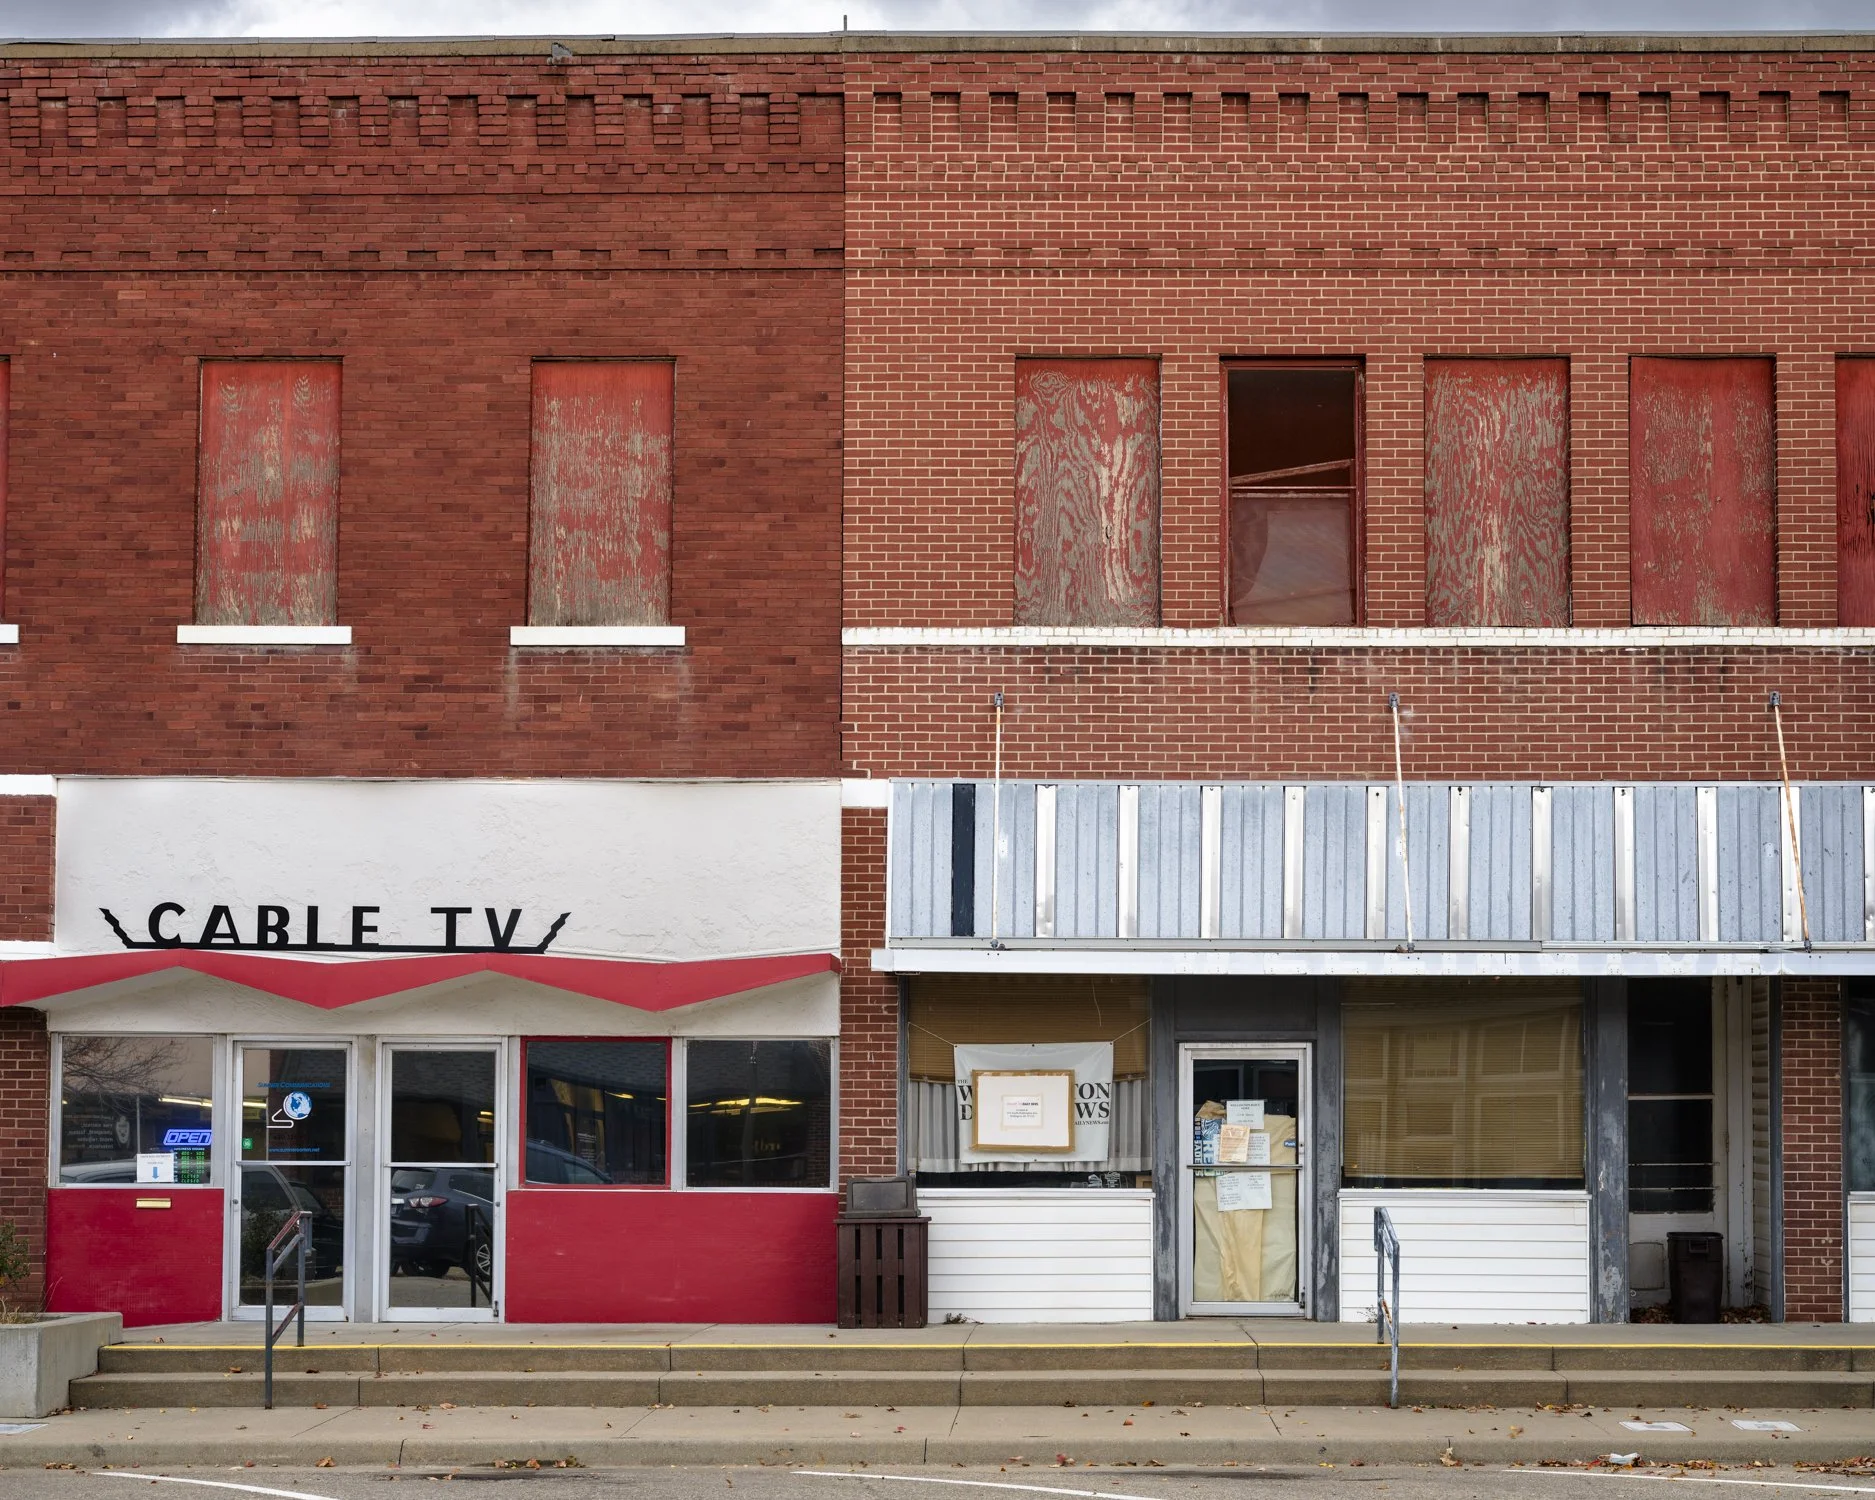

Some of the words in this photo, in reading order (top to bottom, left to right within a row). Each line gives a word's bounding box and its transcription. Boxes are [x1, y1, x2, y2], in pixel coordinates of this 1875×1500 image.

[148, 902, 381, 946] CABLE
[431, 906, 523, 949] TV
[167, 1132, 211, 1143] OPEN
